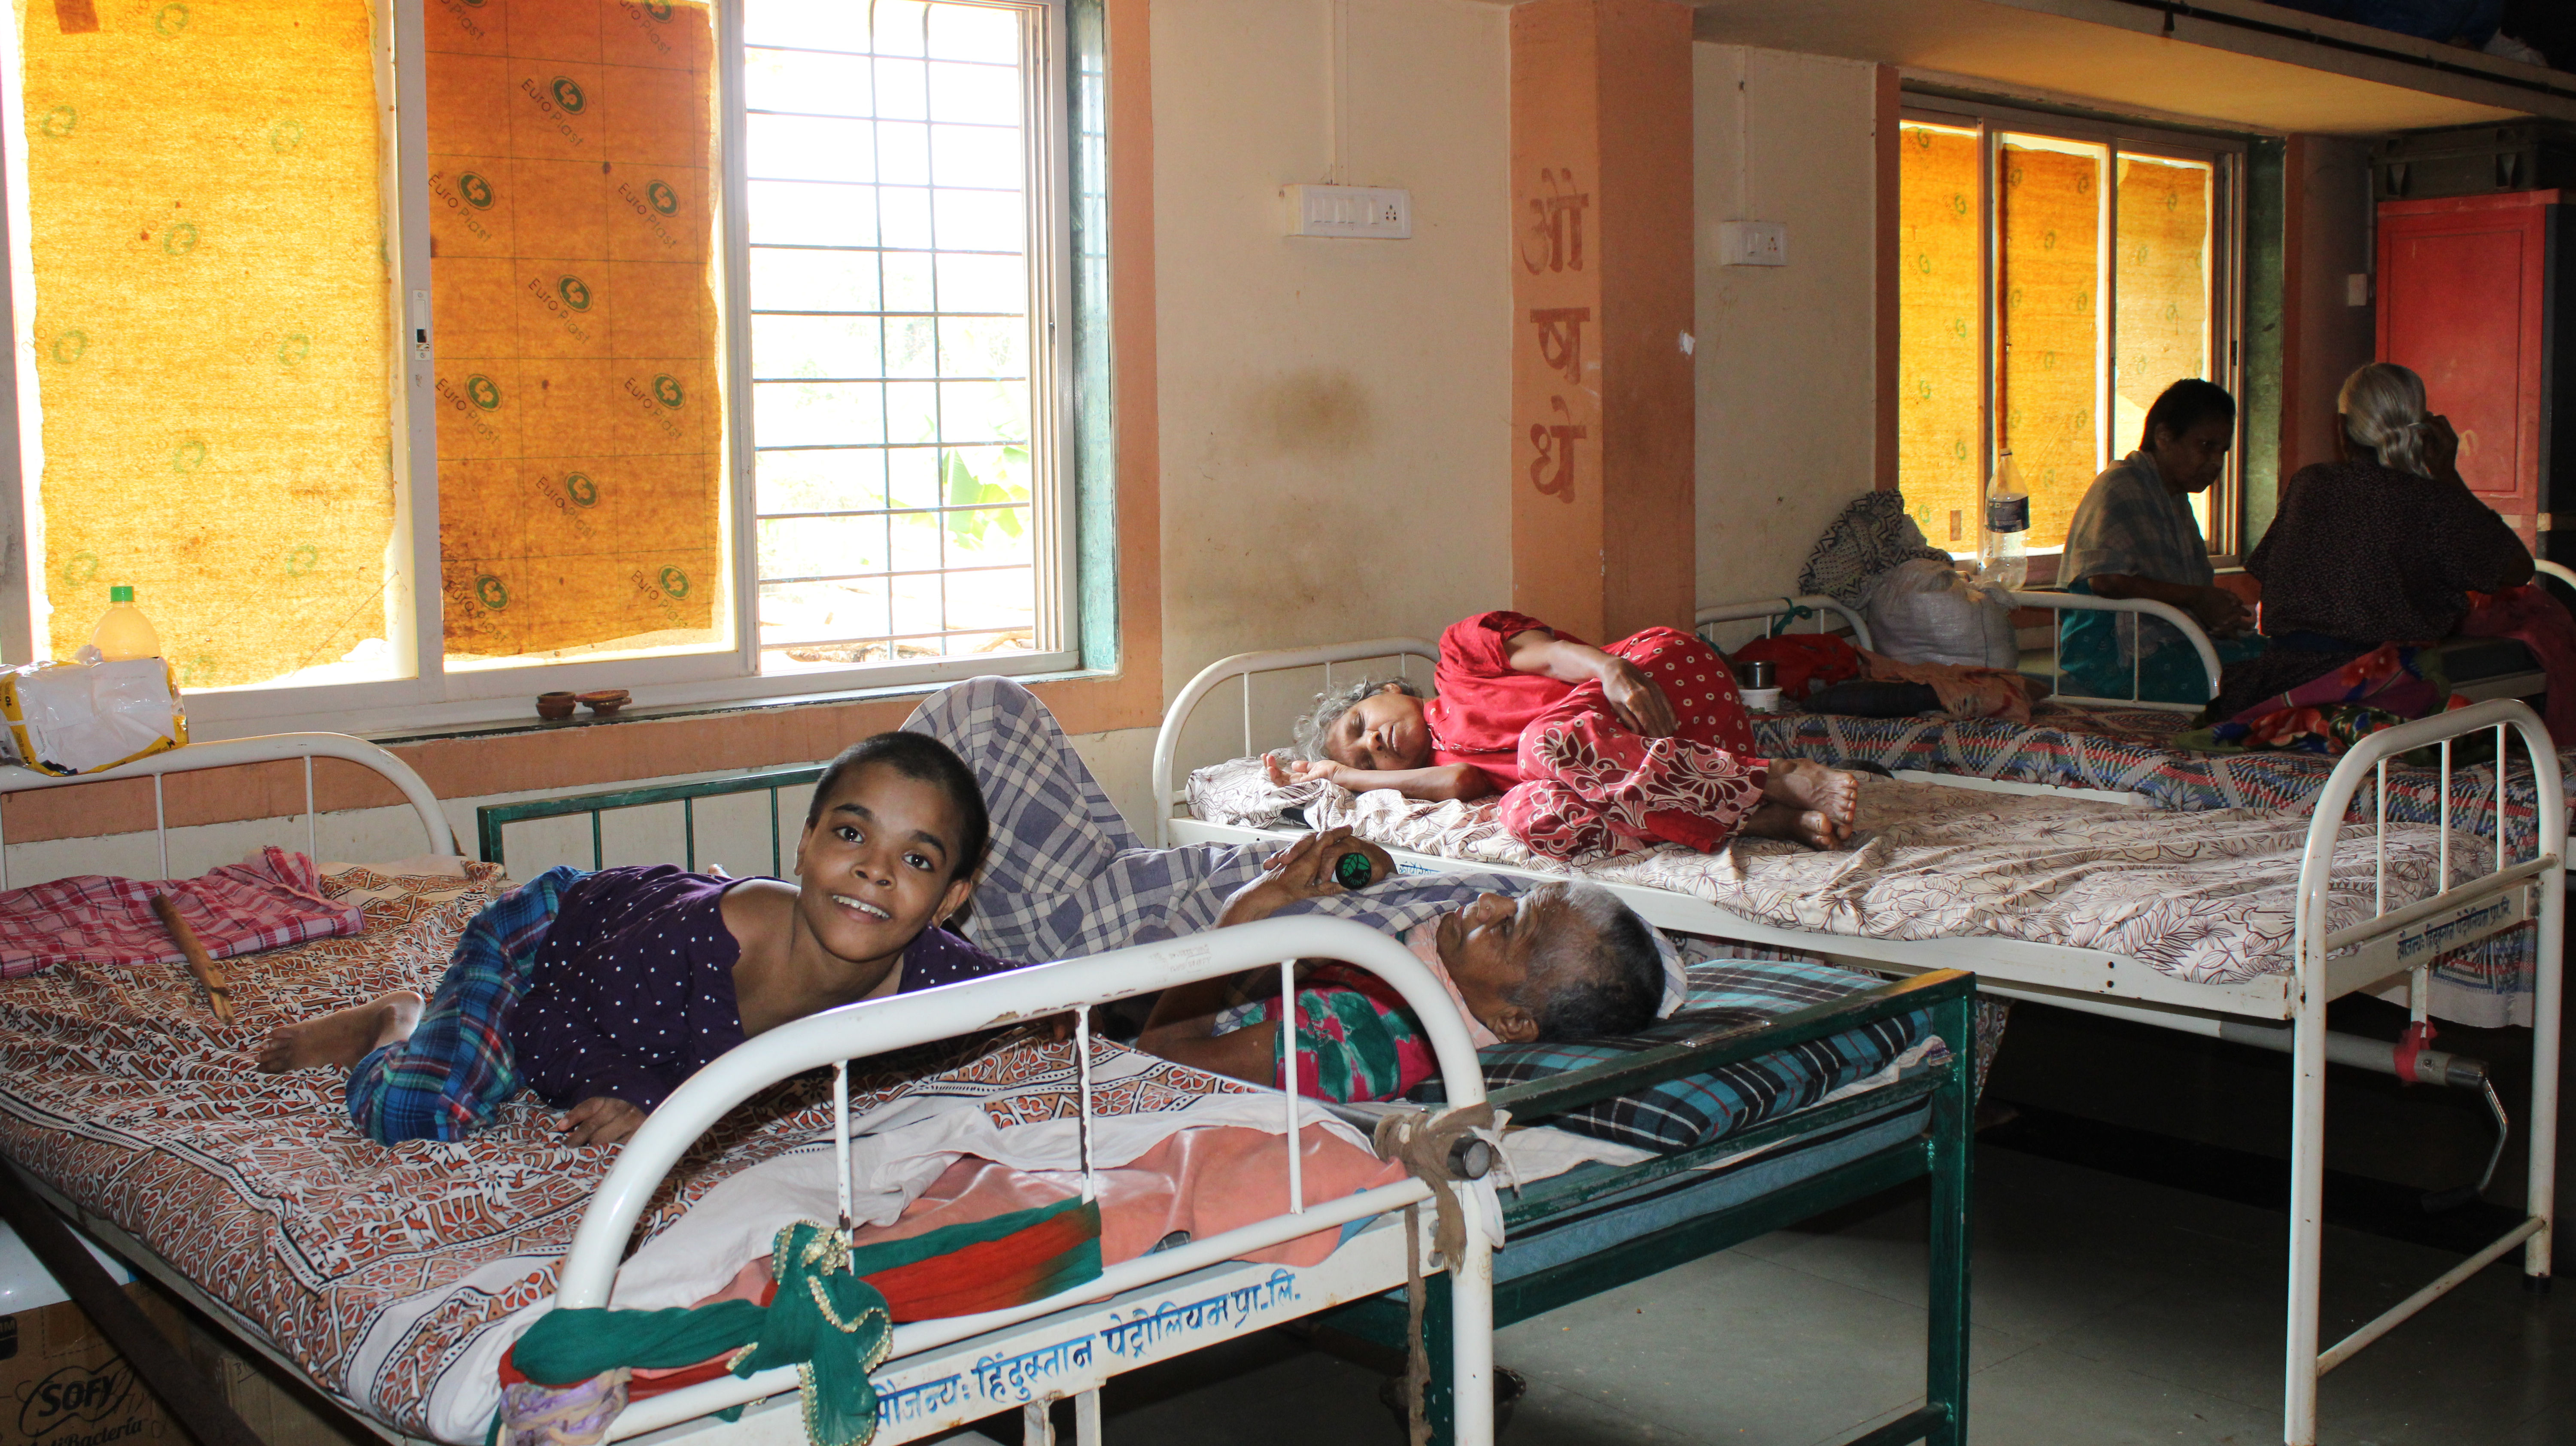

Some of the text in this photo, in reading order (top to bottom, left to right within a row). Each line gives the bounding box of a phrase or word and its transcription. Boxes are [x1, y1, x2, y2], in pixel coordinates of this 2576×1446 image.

[449, 4, 486, 41] Plast
[620, 0, 671, 55] uro Plast
[521, 78, 584, 147] Euro Plast
[428, 174, 492, 243] Euro Plast
[618, 182, 677, 249] Euro Plast
[528, 278, 590, 345] Euro Plast
[435, 378, 466, 410] Euro
[625, 377, 682, 441] Euro Plast
[536, 477, 565, 509] Euro
[444, 580, 474, 612] Euro
[631, 570, 659, 600] Euro
[1348, 871, 1370, 886] ZANDU
[38, 1375, 117, 1417] SOFY
[31, 1416, 143, 1446] Bacteria
